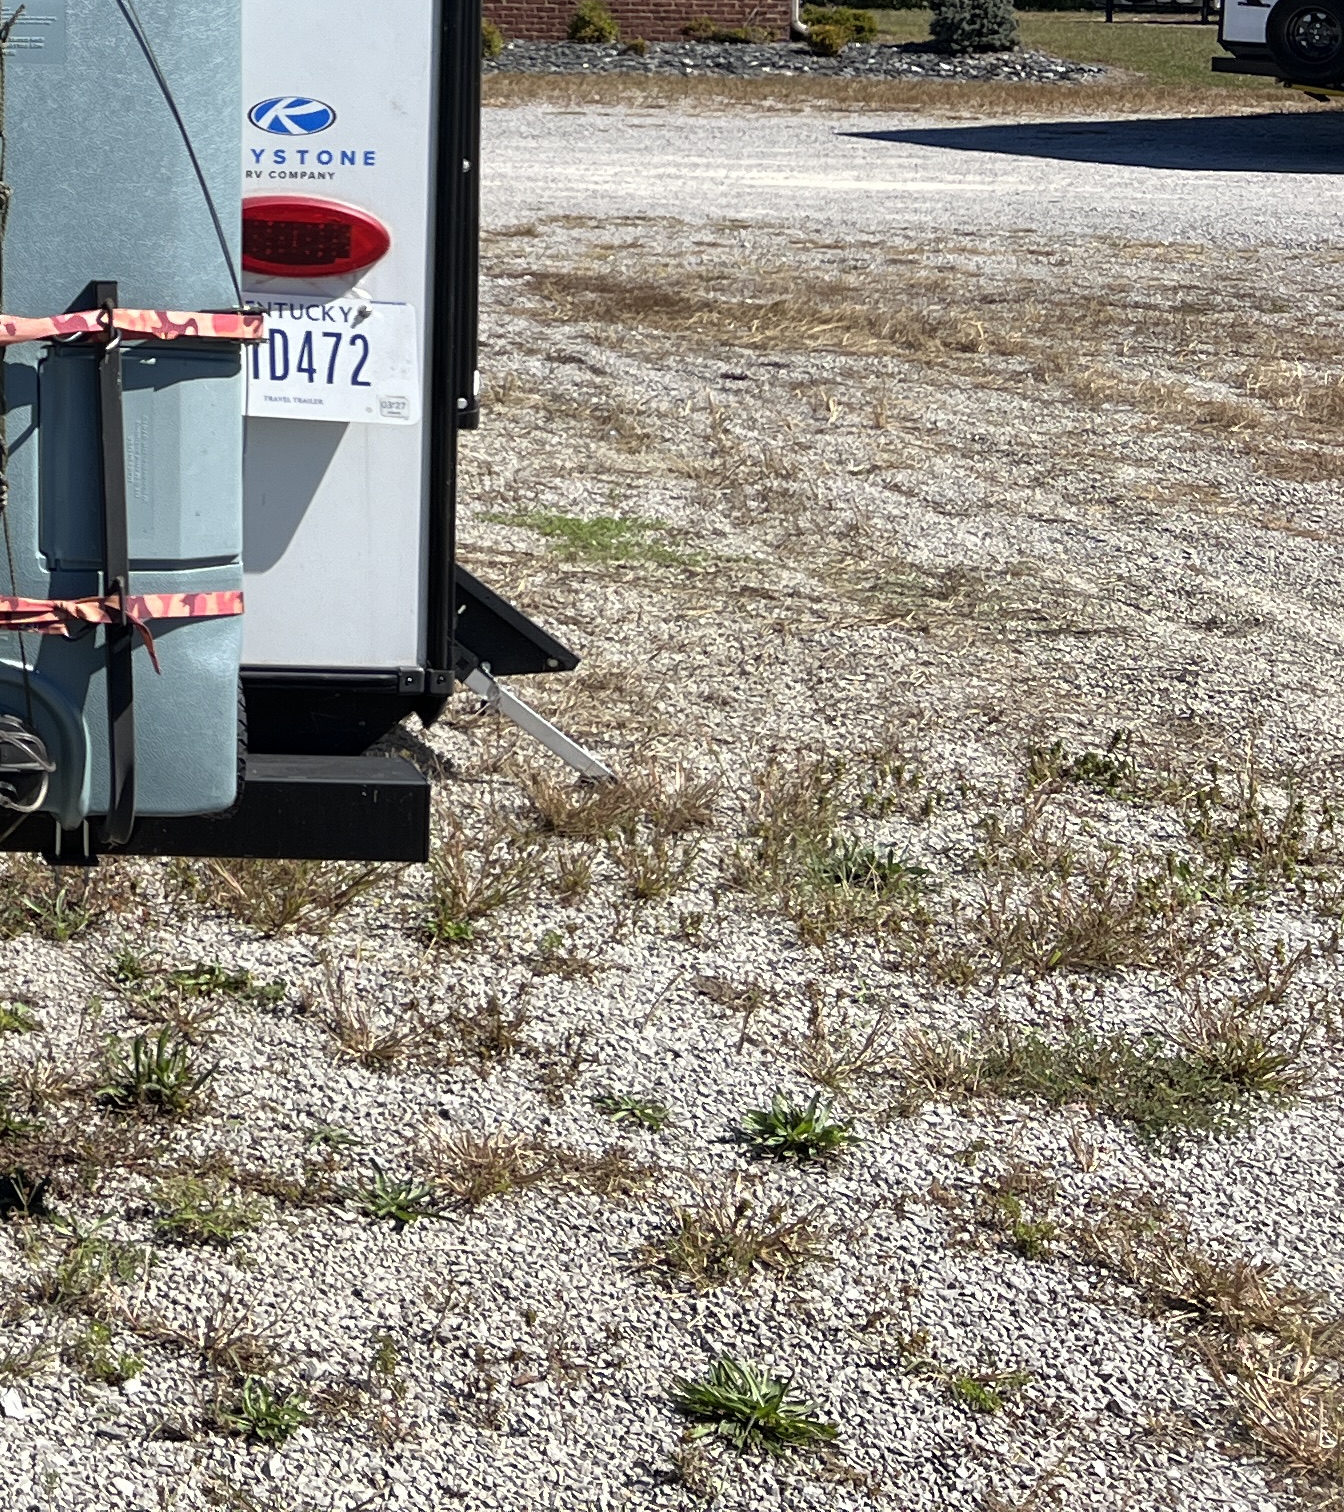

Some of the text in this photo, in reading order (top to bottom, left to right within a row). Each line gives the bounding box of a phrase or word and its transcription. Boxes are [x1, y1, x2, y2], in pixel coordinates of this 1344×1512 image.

[250, 148, 376, 166] YSTONE
[245, 170, 336, 180] RV COMPANY
